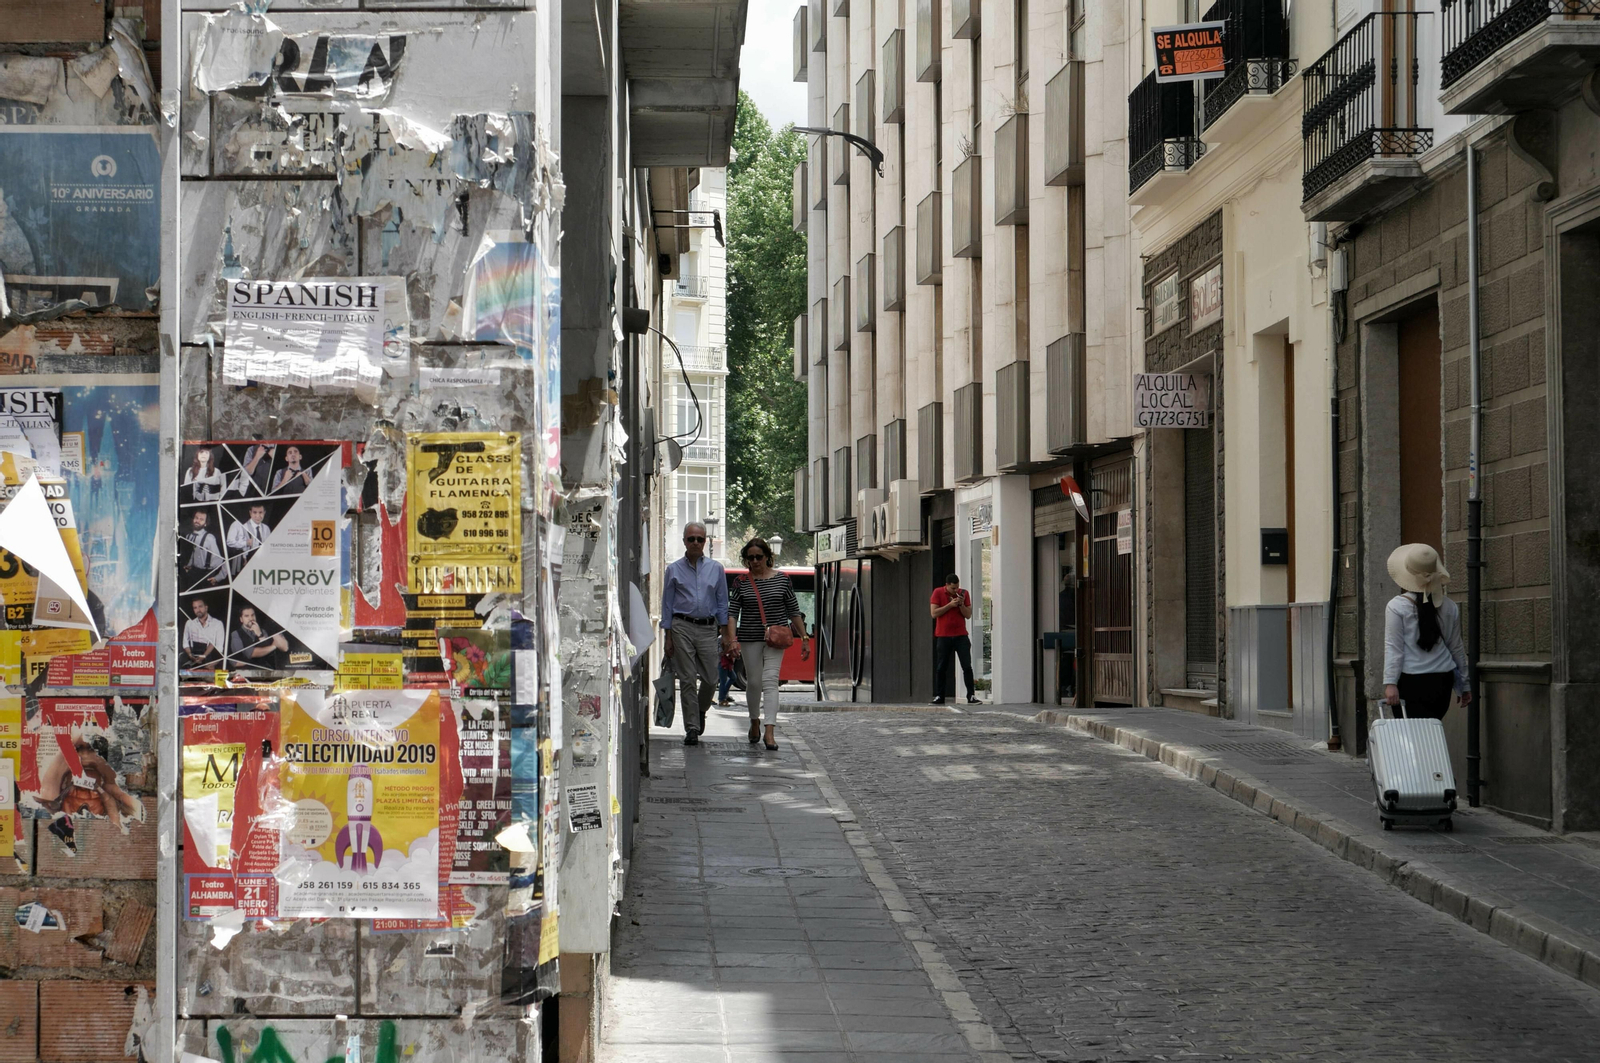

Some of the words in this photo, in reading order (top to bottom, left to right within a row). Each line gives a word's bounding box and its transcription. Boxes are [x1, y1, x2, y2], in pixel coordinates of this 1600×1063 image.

[1157, 34, 1171, 49] SE
[1174, 30, 1222, 48] ALQUILA
[1181, 61, 1209, 72] PISO
[72, 188, 154, 200] ANIVERSARIO
[233, 282, 379, 308] SPANISH
[1136, 374, 1197, 392] ALQUILA
[1141, 393, 1194, 409] LOCAL
[456, 466, 474, 474] DE
[436, 478, 511, 486] GUITARRA
[430, 489, 511, 498] FLAMENCA
[462, 510, 477, 519] 958
[478, 510, 493, 518] 262
[313, 527, 333, 541] 10
[463, 529, 477, 538] 610
[313, 542, 333, 550] mayo
[252, 586, 335, 595] #SoloLosValientes
[7, 607, 25, 619] B2
[122, 649, 145, 657] Teatro
[112, 660, 154, 668] ALHAMBRA
[351, 701, 392, 709] PUERTA
[468, 720, 476, 729] LA
[312, 729, 350, 742] CURSO
[463, 741, 475, 749] SEX
[284, 743, 395, 763] SELECTIVIDAD
[397, 744, 436, 763] 2019
[476, 801, 496, 809] GREEN
[468, 811, 477, 819] OZ
[201, 880, 225, 888] Teatro
[190, 891, 235, 899] ALHAMBRA
[244, 887, 261, 899] 21
